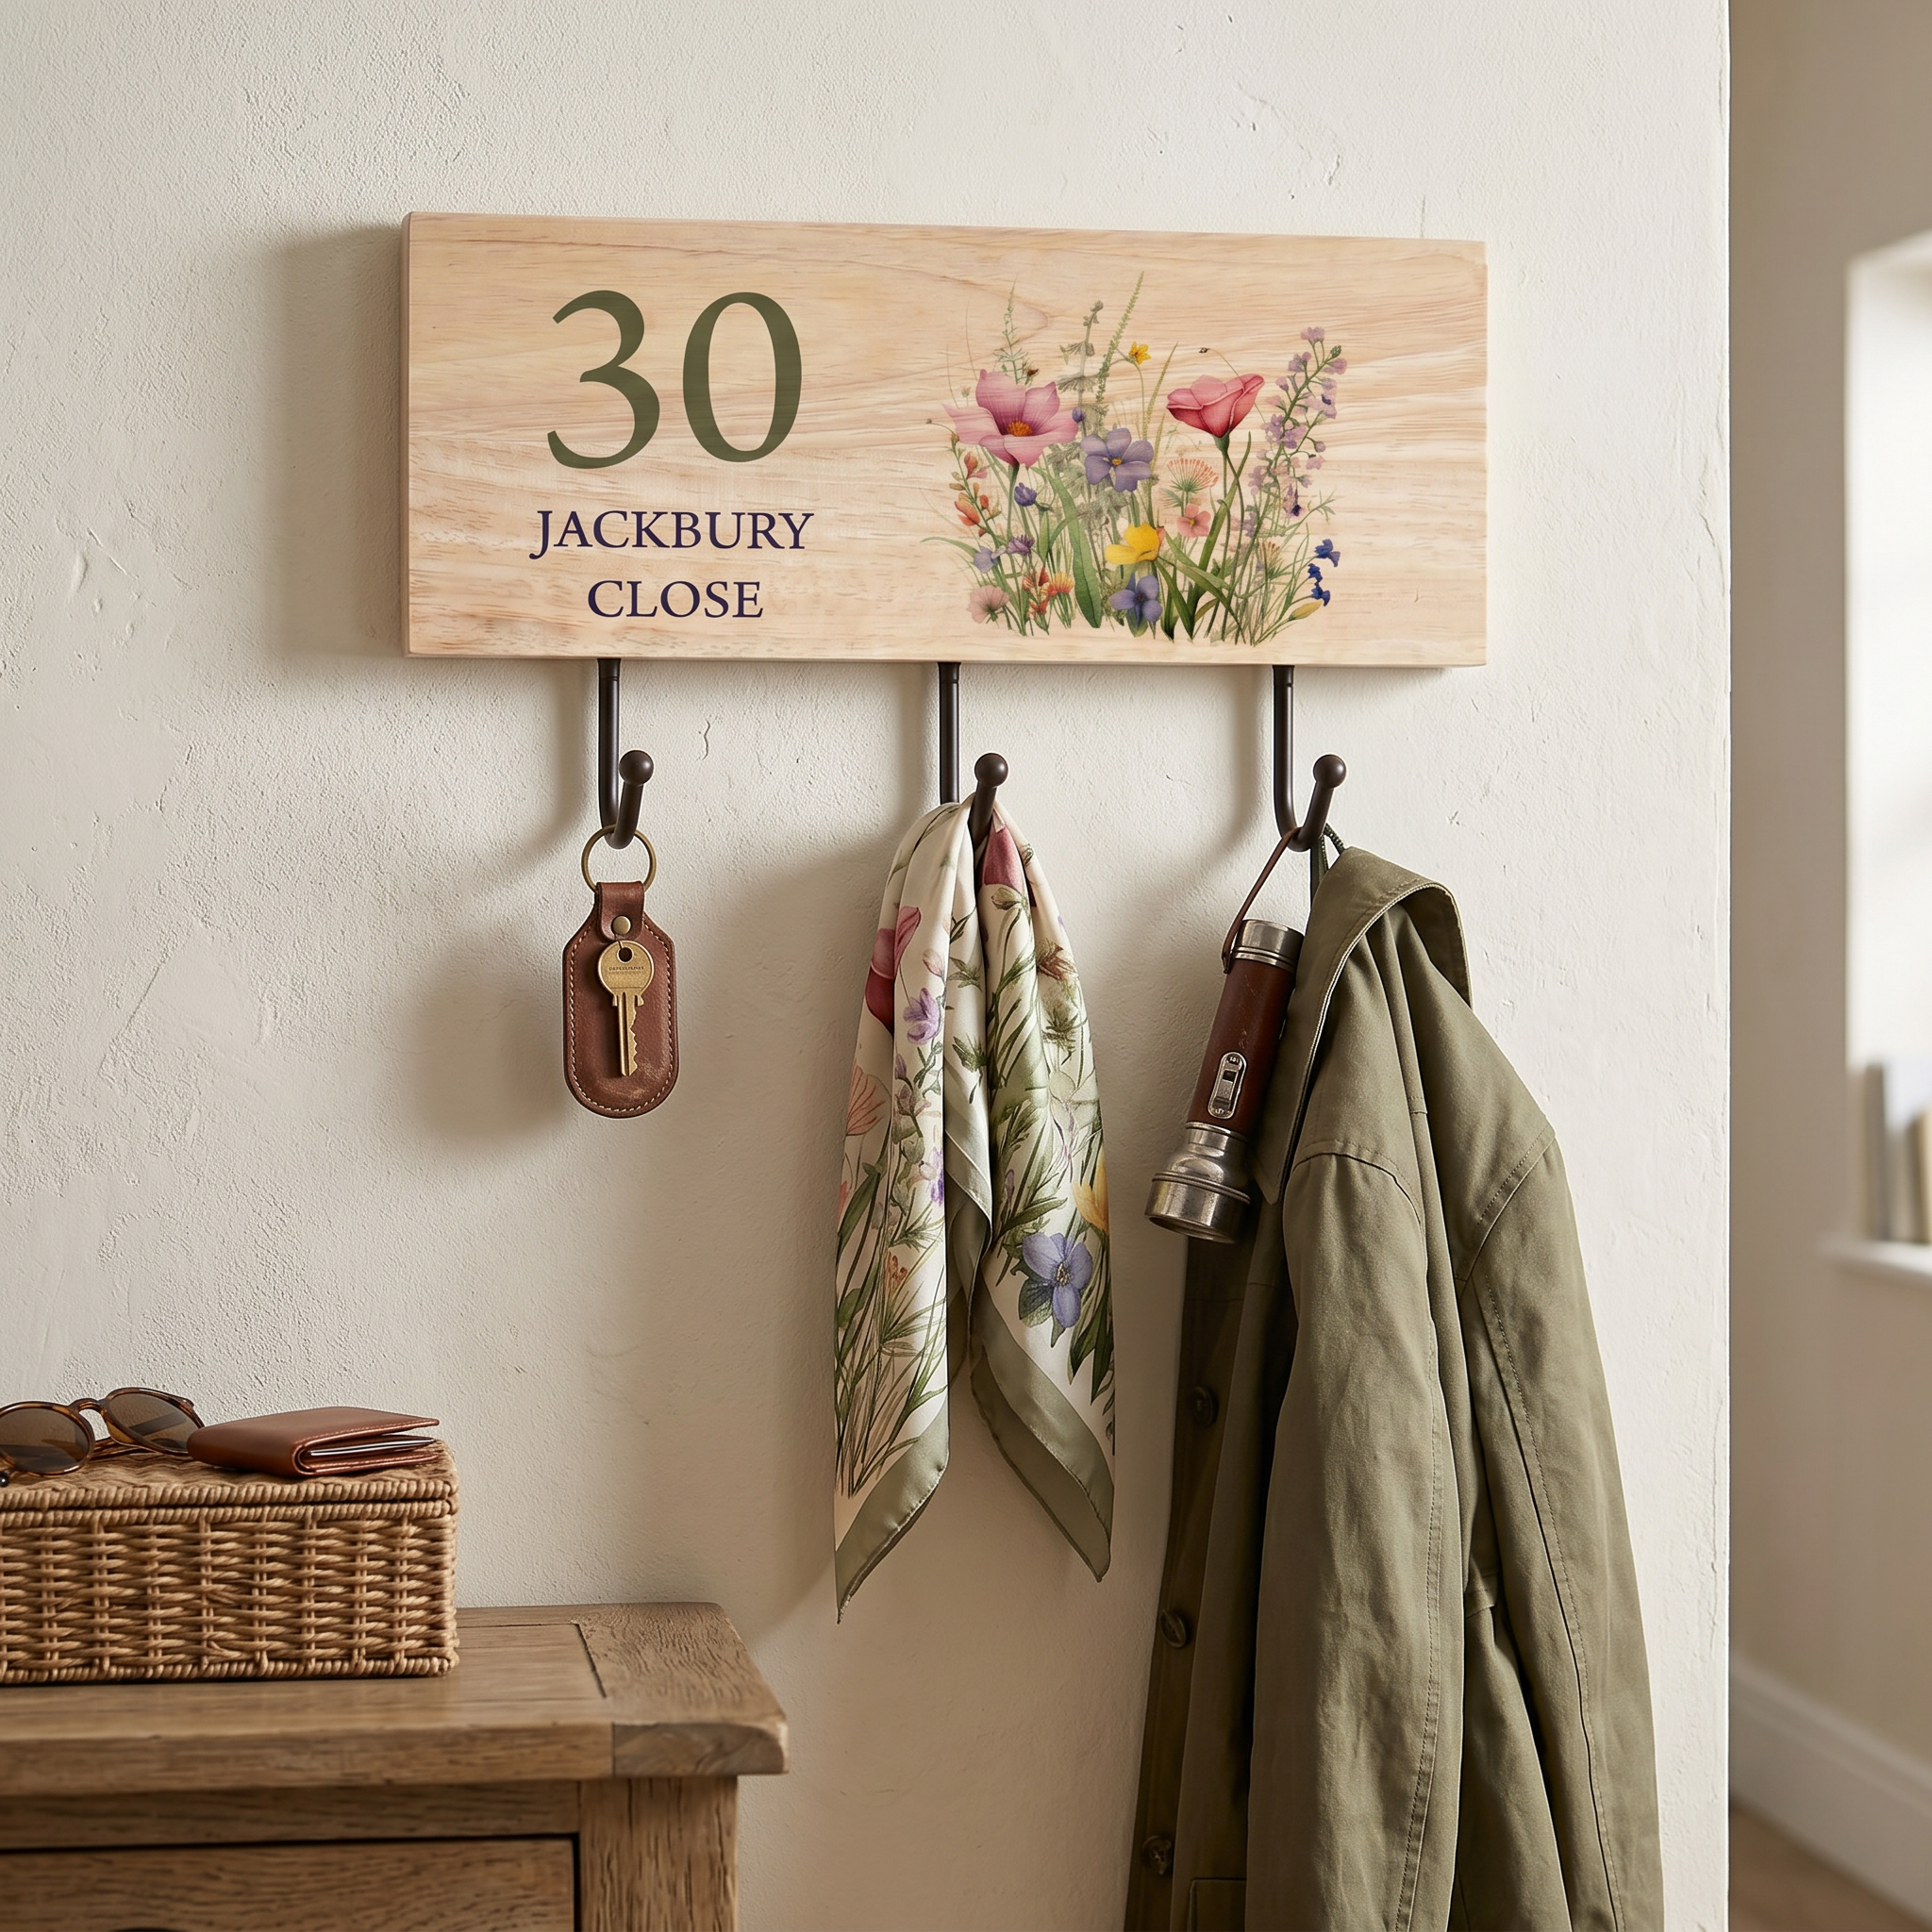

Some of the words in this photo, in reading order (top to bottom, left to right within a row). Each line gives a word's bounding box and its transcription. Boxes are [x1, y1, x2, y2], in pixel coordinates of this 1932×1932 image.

[547, 290, 802, 469] 30
[529, 510, 814, 559] JACKBURY
[588, 580, 763, 618] CLOSE
